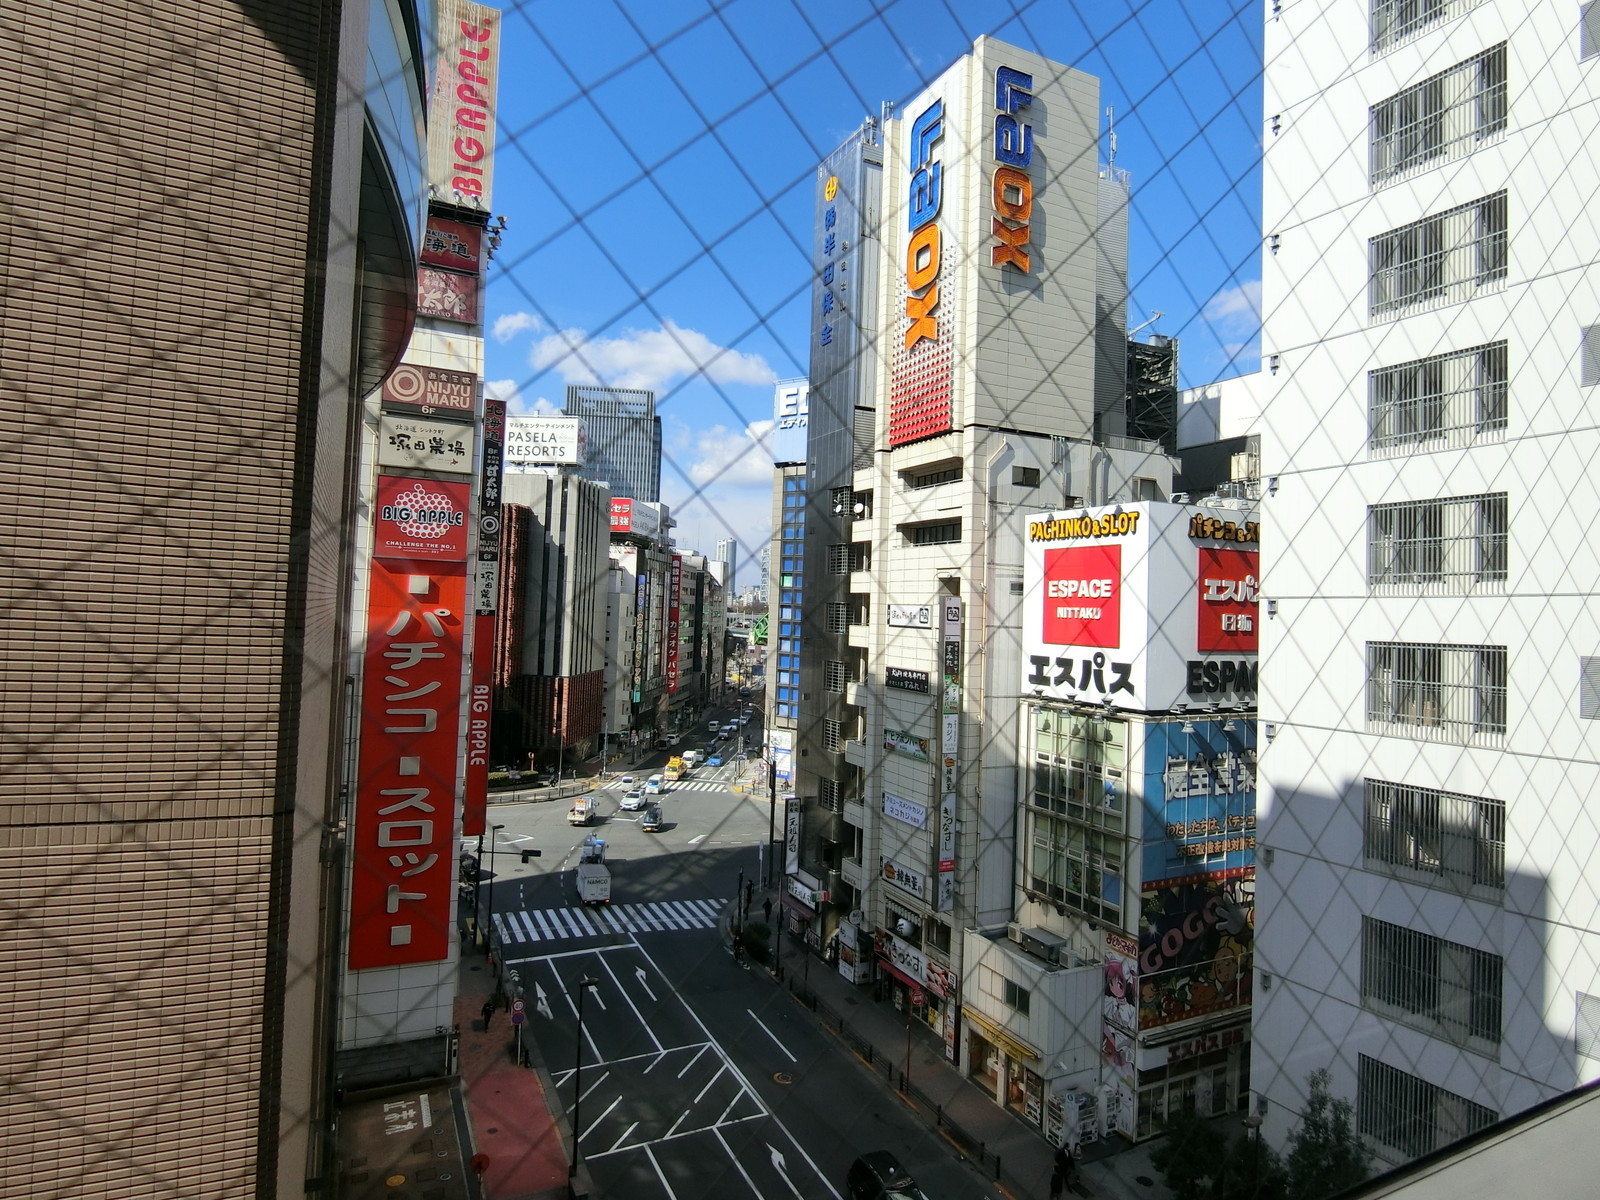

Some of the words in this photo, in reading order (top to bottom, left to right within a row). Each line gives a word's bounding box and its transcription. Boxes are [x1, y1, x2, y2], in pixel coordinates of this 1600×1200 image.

[452, 136, 485, 197] BIG
[418, 287, 467, 316] 太郎
[427, 381, 470, 397] NIJYU
[421, 405, 436, 415] 6F
[426, 392, 470, 409] MARU
[395, 424, 417, 433] 北海道
[486, 404, 504, 445] 北海道
[509, 422, 575, 430] マルチエンターテインメント
[389, 433, 465, 456] 塚田農場
[508, 431, 557, 443] PASELA
[507, 445, 566, 457] RESORTS
[485, 465, 499, 500] 甘太郎
[382, 505, 412, 521] BIG
[417, 509, 464, 526] APPLE
[1189, 513, 1260, 544] パチンコ&ス
[386, 540, 424, 548] CHALLENGE
[480, 540, 498, 548] NIJYU
[1048, 579, 1113, 599] ESPACE
[1056, 606, 1102, 621] NITTAKU
[383, 608, 451, 733] パチンコ
[1028, 652, 1135, 696] エスパス
[473, 684, 489, 713] BIG
[470, 719, 486, 766] APPLE
[378, 788, 439, 914] スロット
